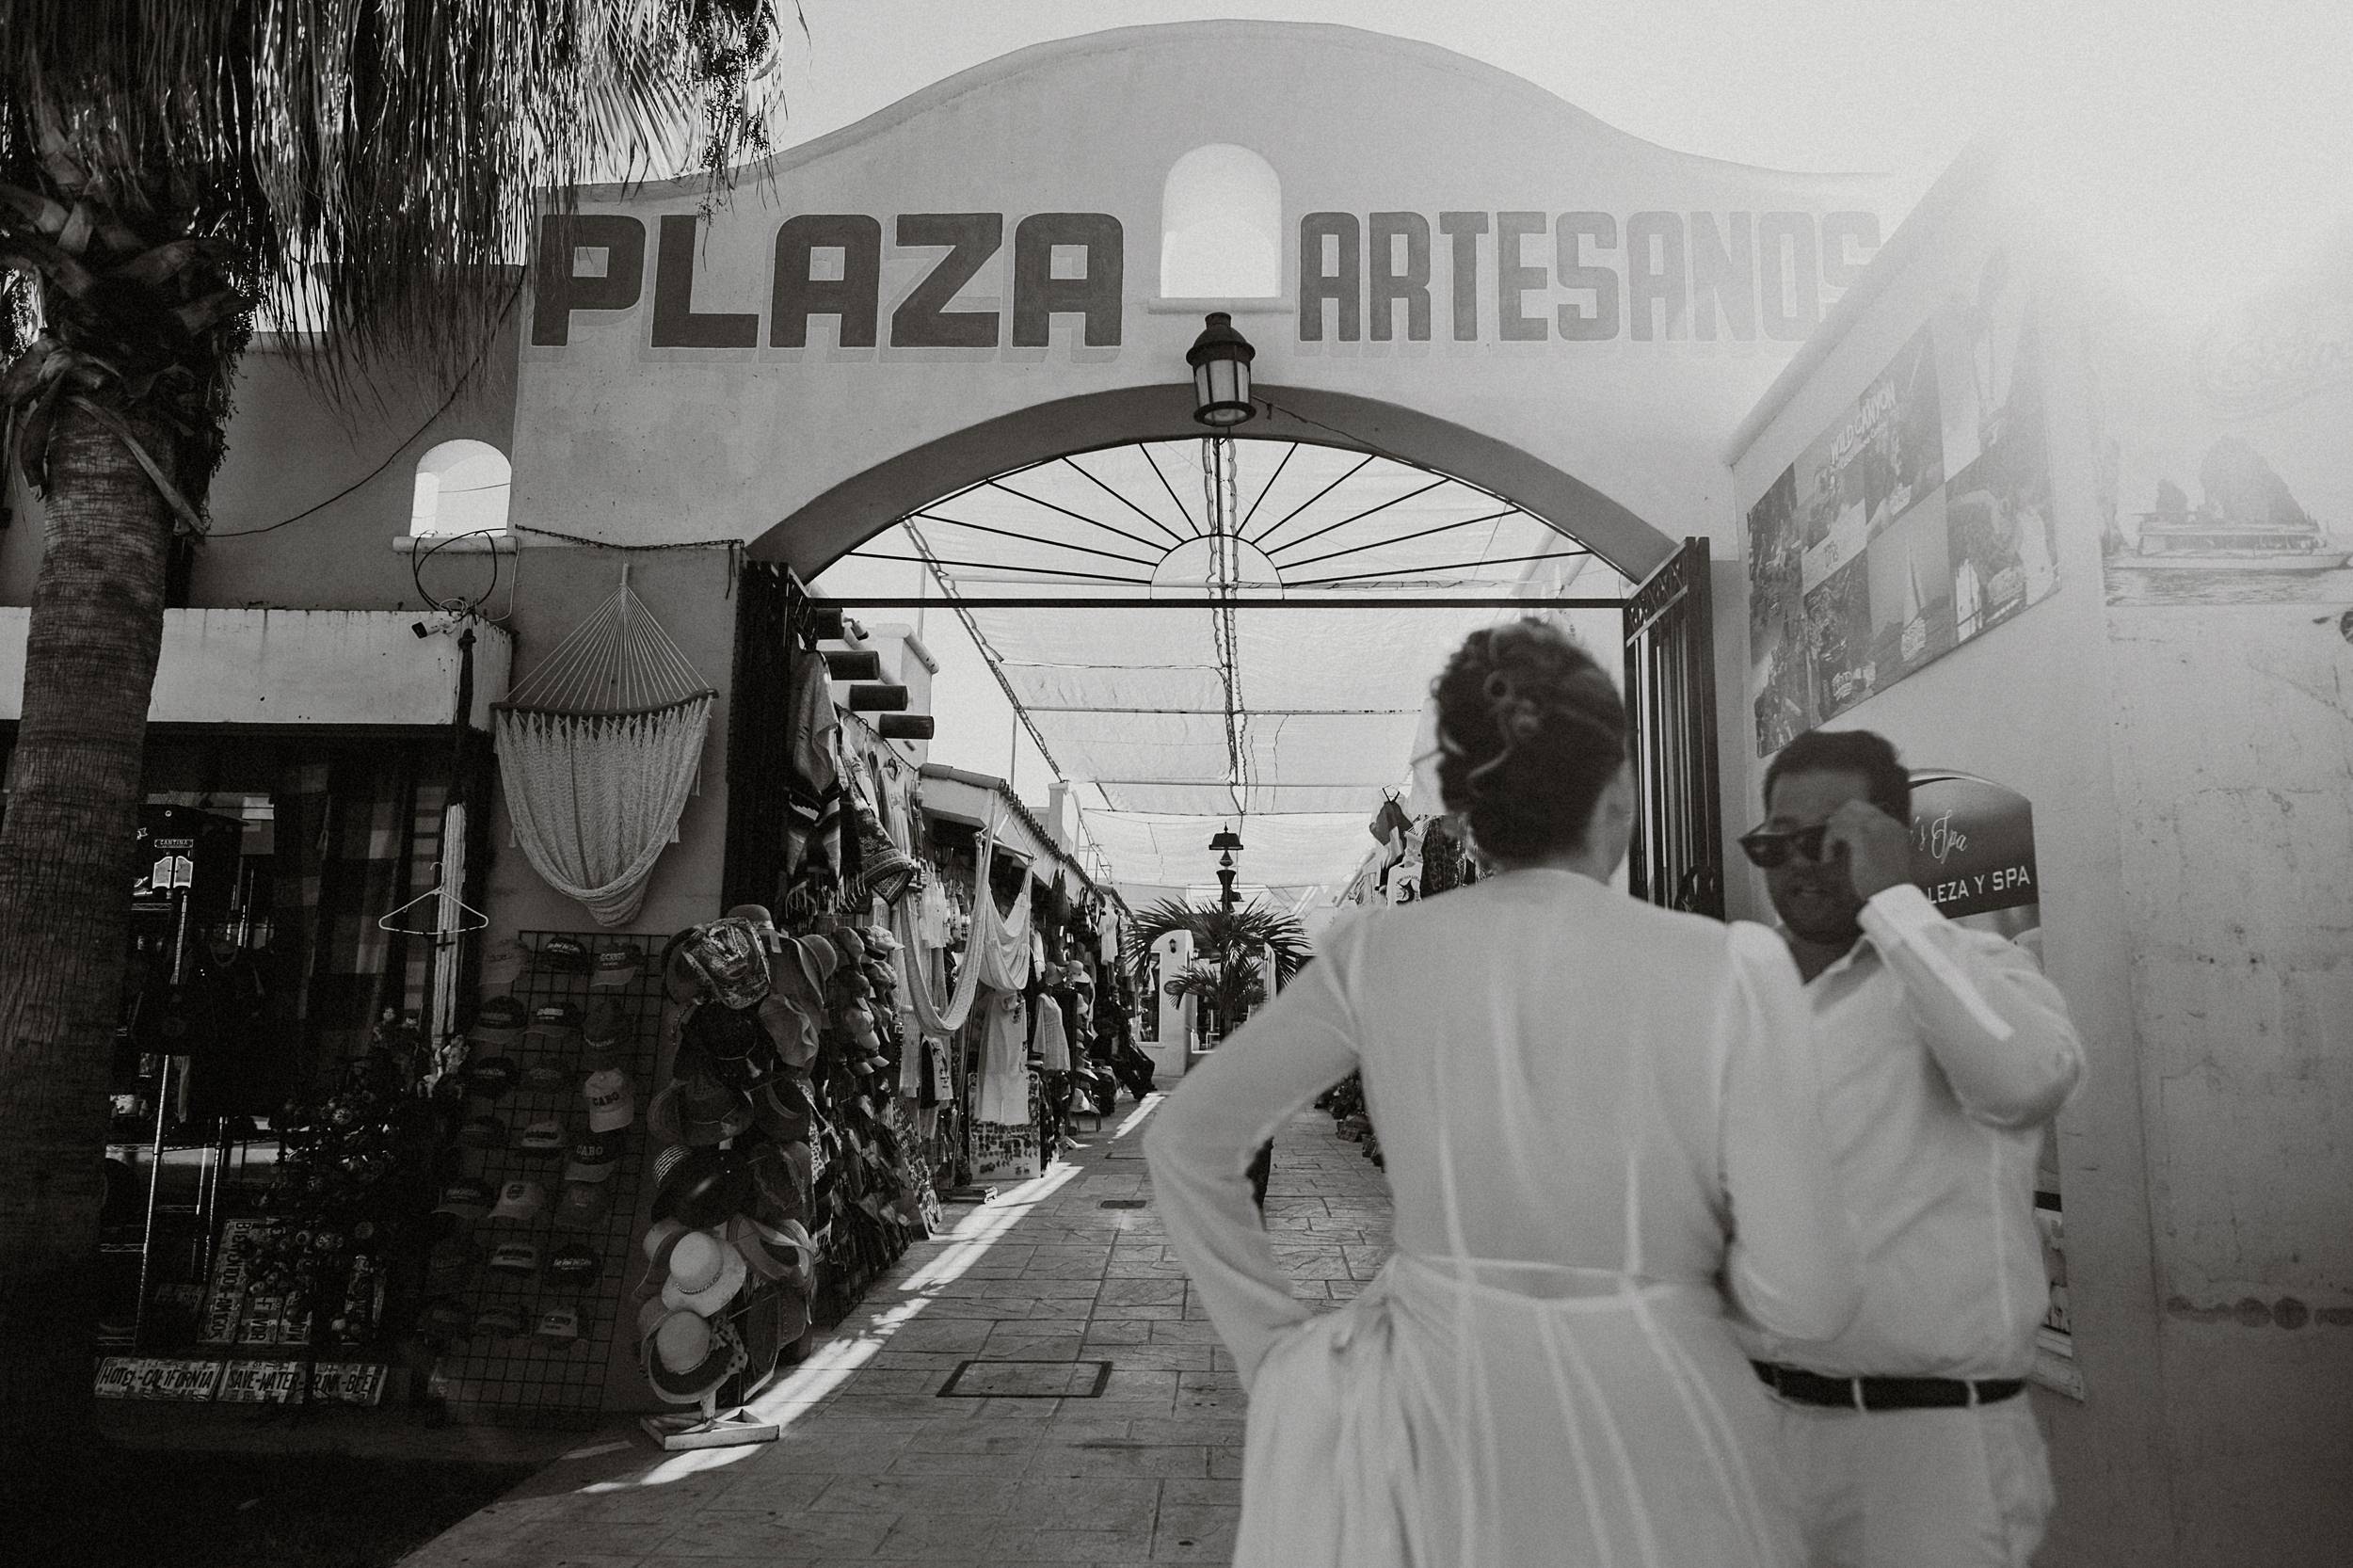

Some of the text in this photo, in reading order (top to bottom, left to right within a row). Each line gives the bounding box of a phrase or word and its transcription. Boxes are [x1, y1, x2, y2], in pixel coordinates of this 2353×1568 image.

[530, 211, 1881, 348] PLAZA ARTESANOS
[1830, 424, 1854, 465] WILD
[1854, 379, 1897, 434] CANYON
[1928, 866, 2031, 904] LEZA Y SPA
[593, 1092, 620, 1107] CABO
[576, 1144, 603, 1156] CABO
